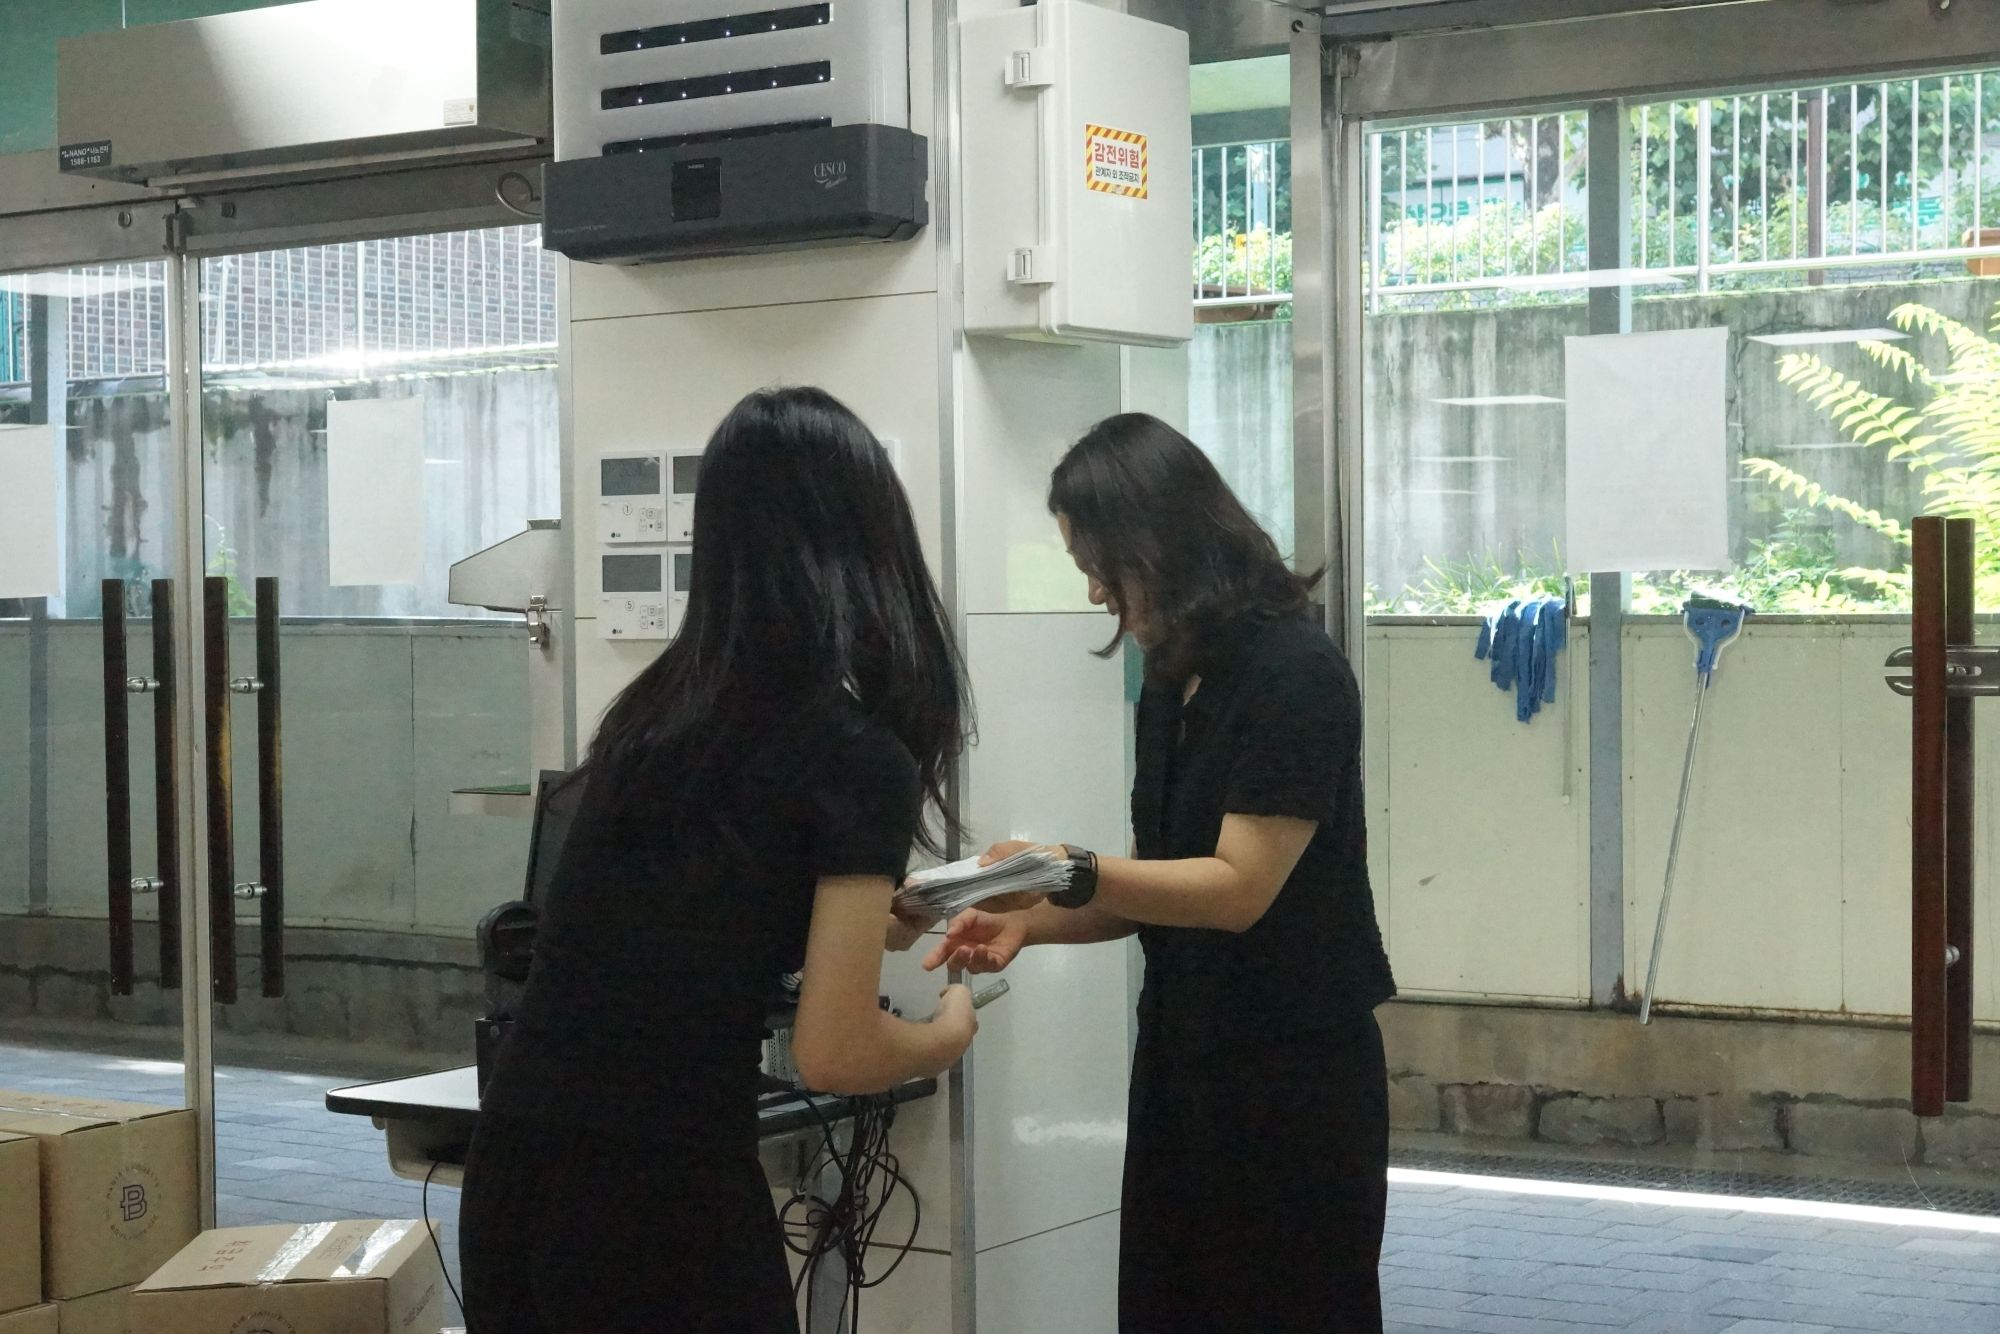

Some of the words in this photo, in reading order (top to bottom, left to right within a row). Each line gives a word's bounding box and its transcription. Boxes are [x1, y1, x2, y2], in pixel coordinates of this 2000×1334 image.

[1094, 142, 1140, 169] 감전위험
[1095, 166, 1112, 179] 관계자
[1112, 169, 1118, 179] 외
[1118, 170, 1140, 184] 조작금지
